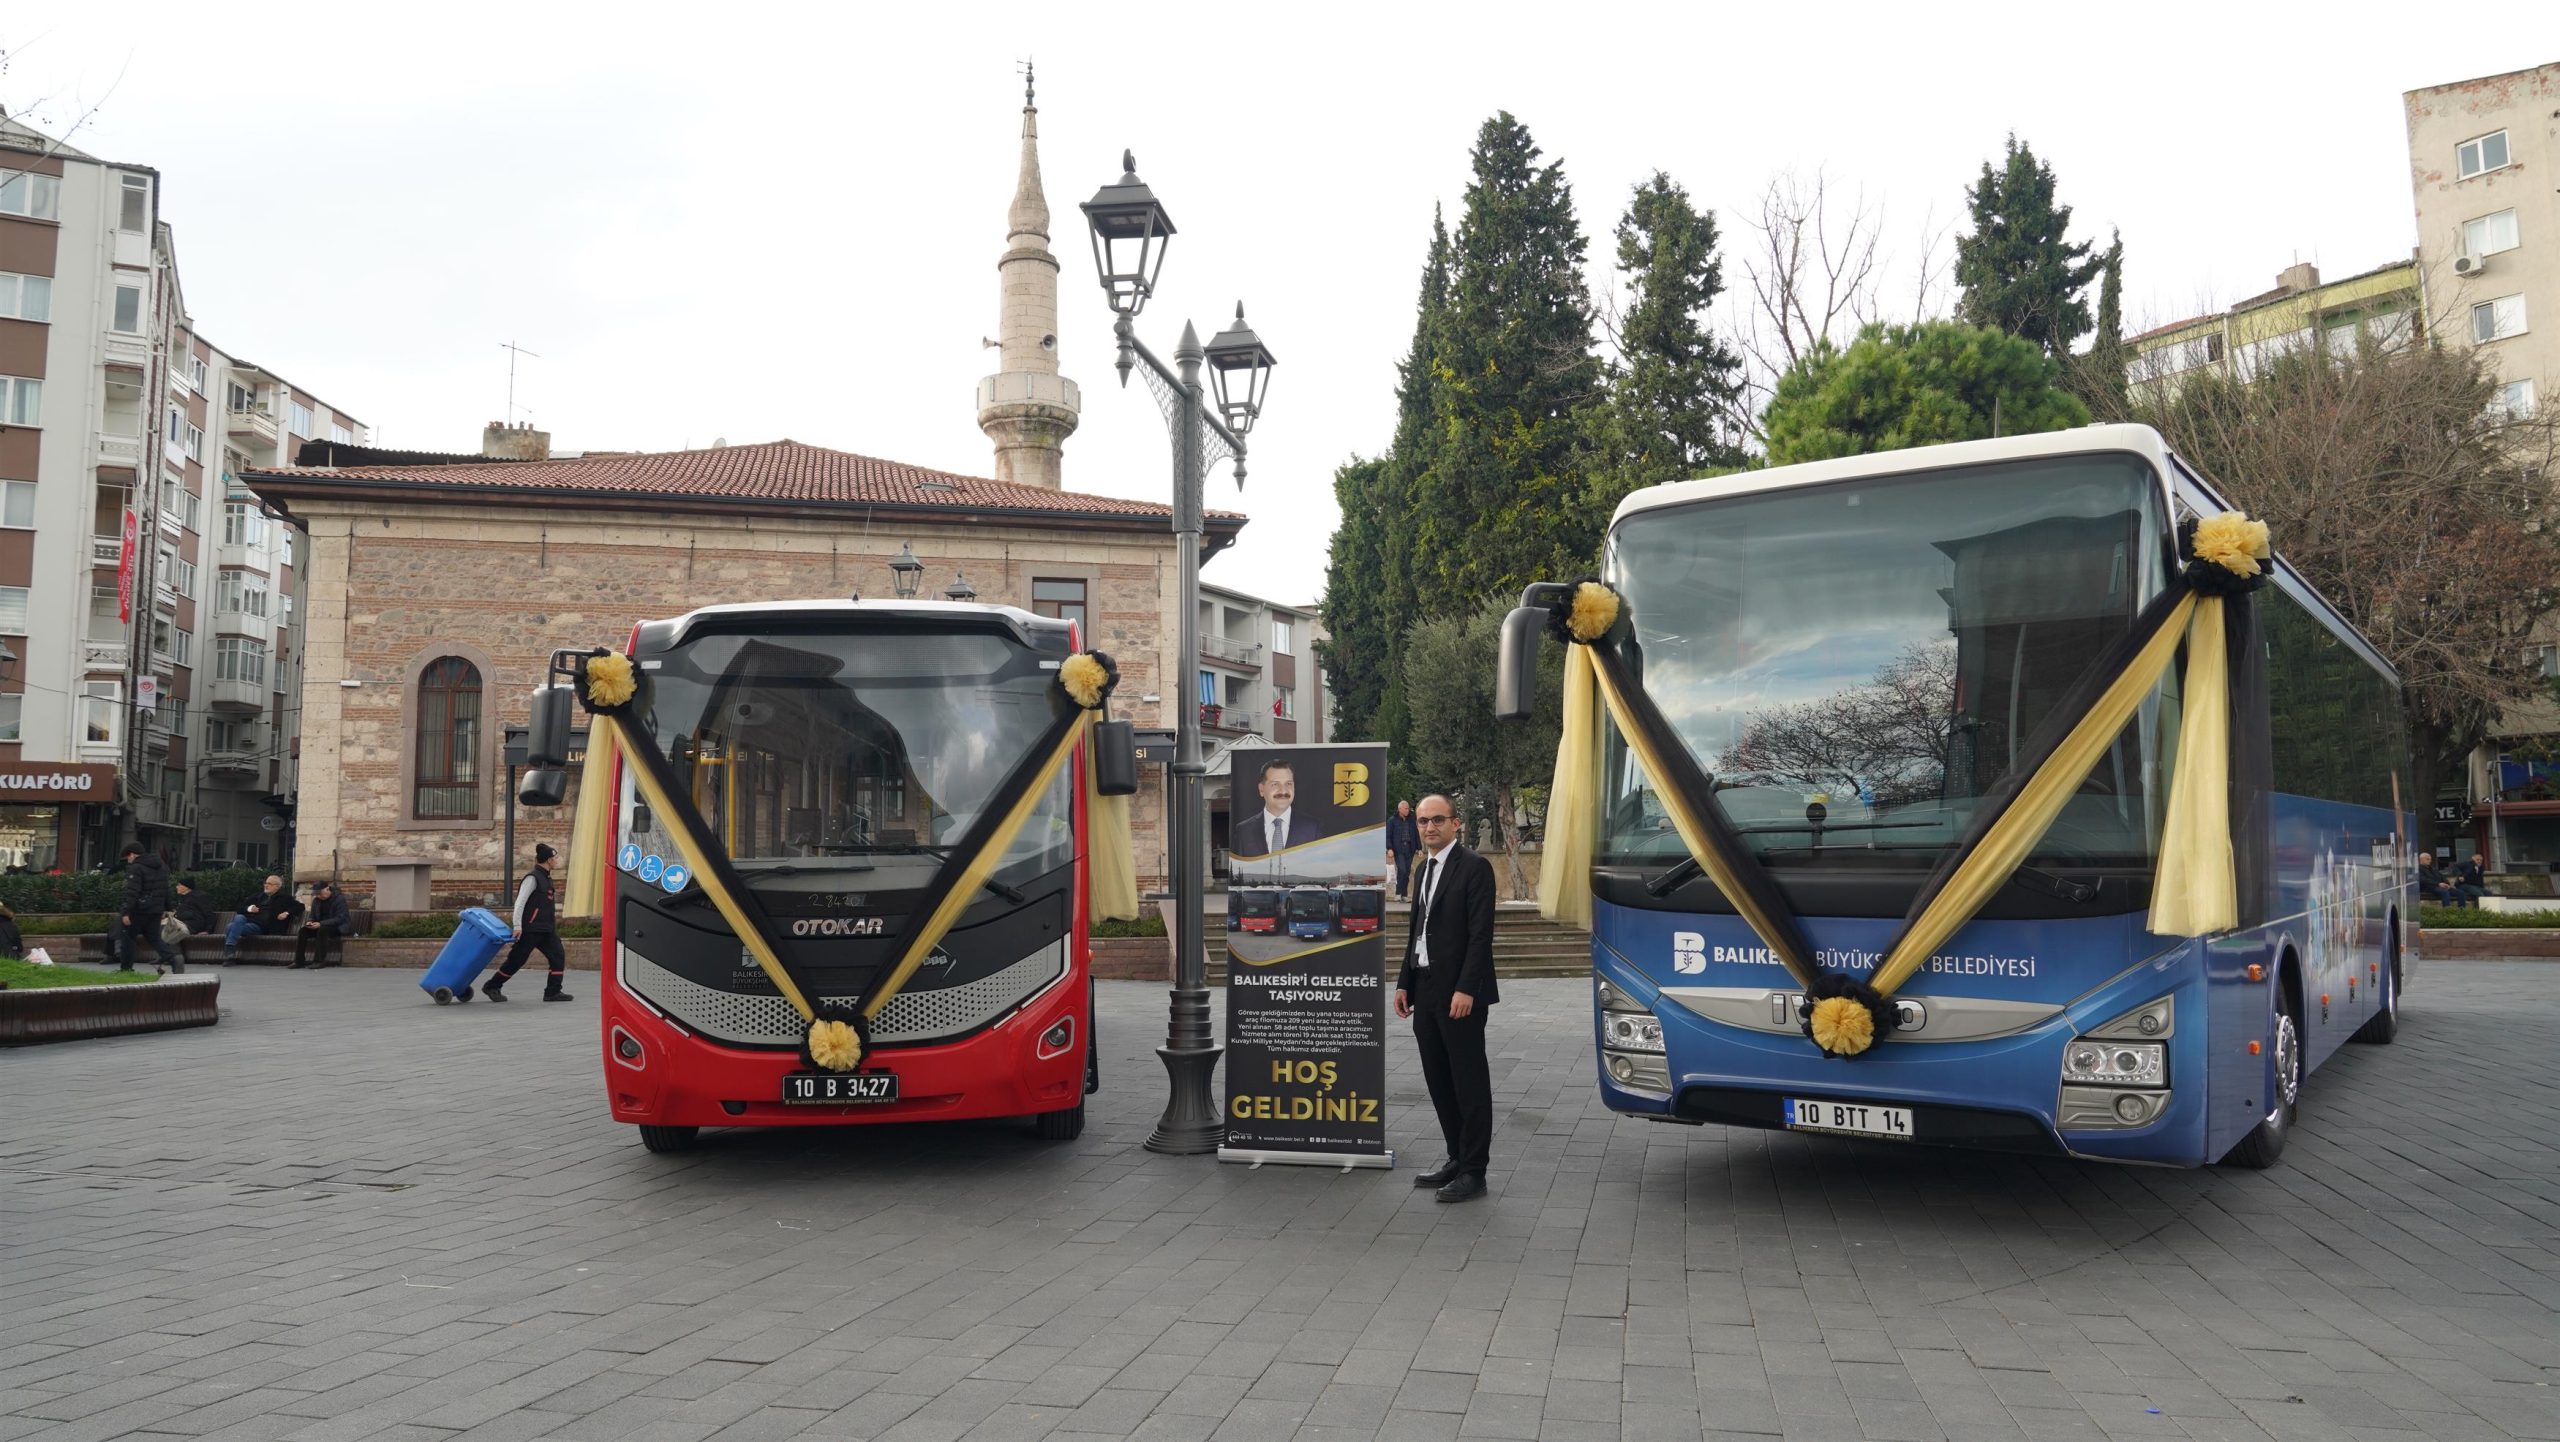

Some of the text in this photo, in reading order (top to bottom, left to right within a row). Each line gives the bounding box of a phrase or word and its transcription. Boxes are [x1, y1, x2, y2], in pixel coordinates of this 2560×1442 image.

[792, 917, 884, 936] OTOKAR
[1713, 946, 1785, 966] BALIKE
[1932, 954, 2036, 977] BELEDİYESİ
[1310, 974, 1378, 988] GELECEĞE
[1269, 990, 1342, 1003] TAŞIYORUZ
[795, 1078, 890, 1097] 10 B 3427
[1271, 1060, 1338, 1091] HOŞ
[1231, 1090, 1379, 1122] GELDİNİZ
[1798, 1102, 1905, 1132] 10 BTT 14
